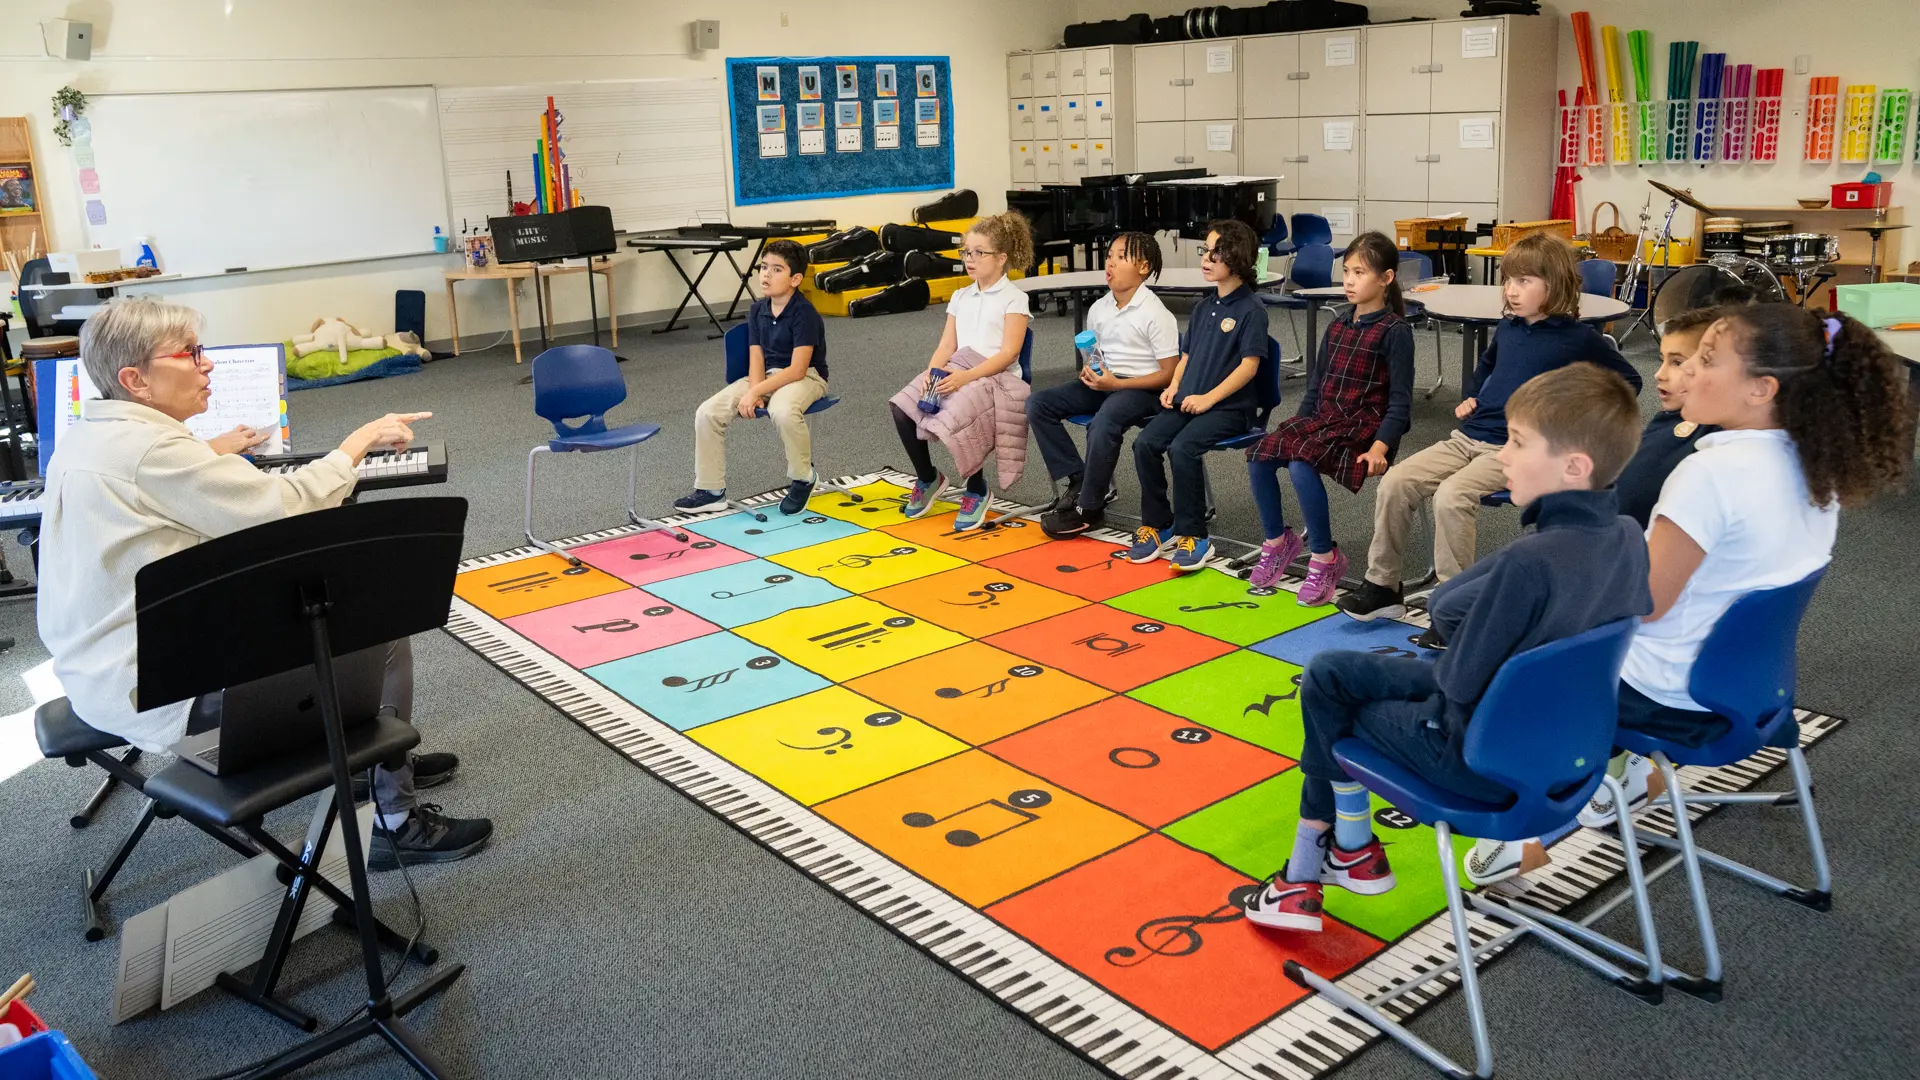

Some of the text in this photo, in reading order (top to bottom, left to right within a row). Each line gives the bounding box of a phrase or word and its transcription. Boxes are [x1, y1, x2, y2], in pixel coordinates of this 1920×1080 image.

[516, 235, 548, 245] MUSIC
[989, 583, 1009, 591] 15
[1136, 624, 1160, 633] 16
[1013, 666, 1036, 676] 10
[876, 715, 892, 724] 4
[1176, 730, 1203, 742] 11
[1020, 793, 1041, 803] 5
[1380, 810, 1413, 827] 12
